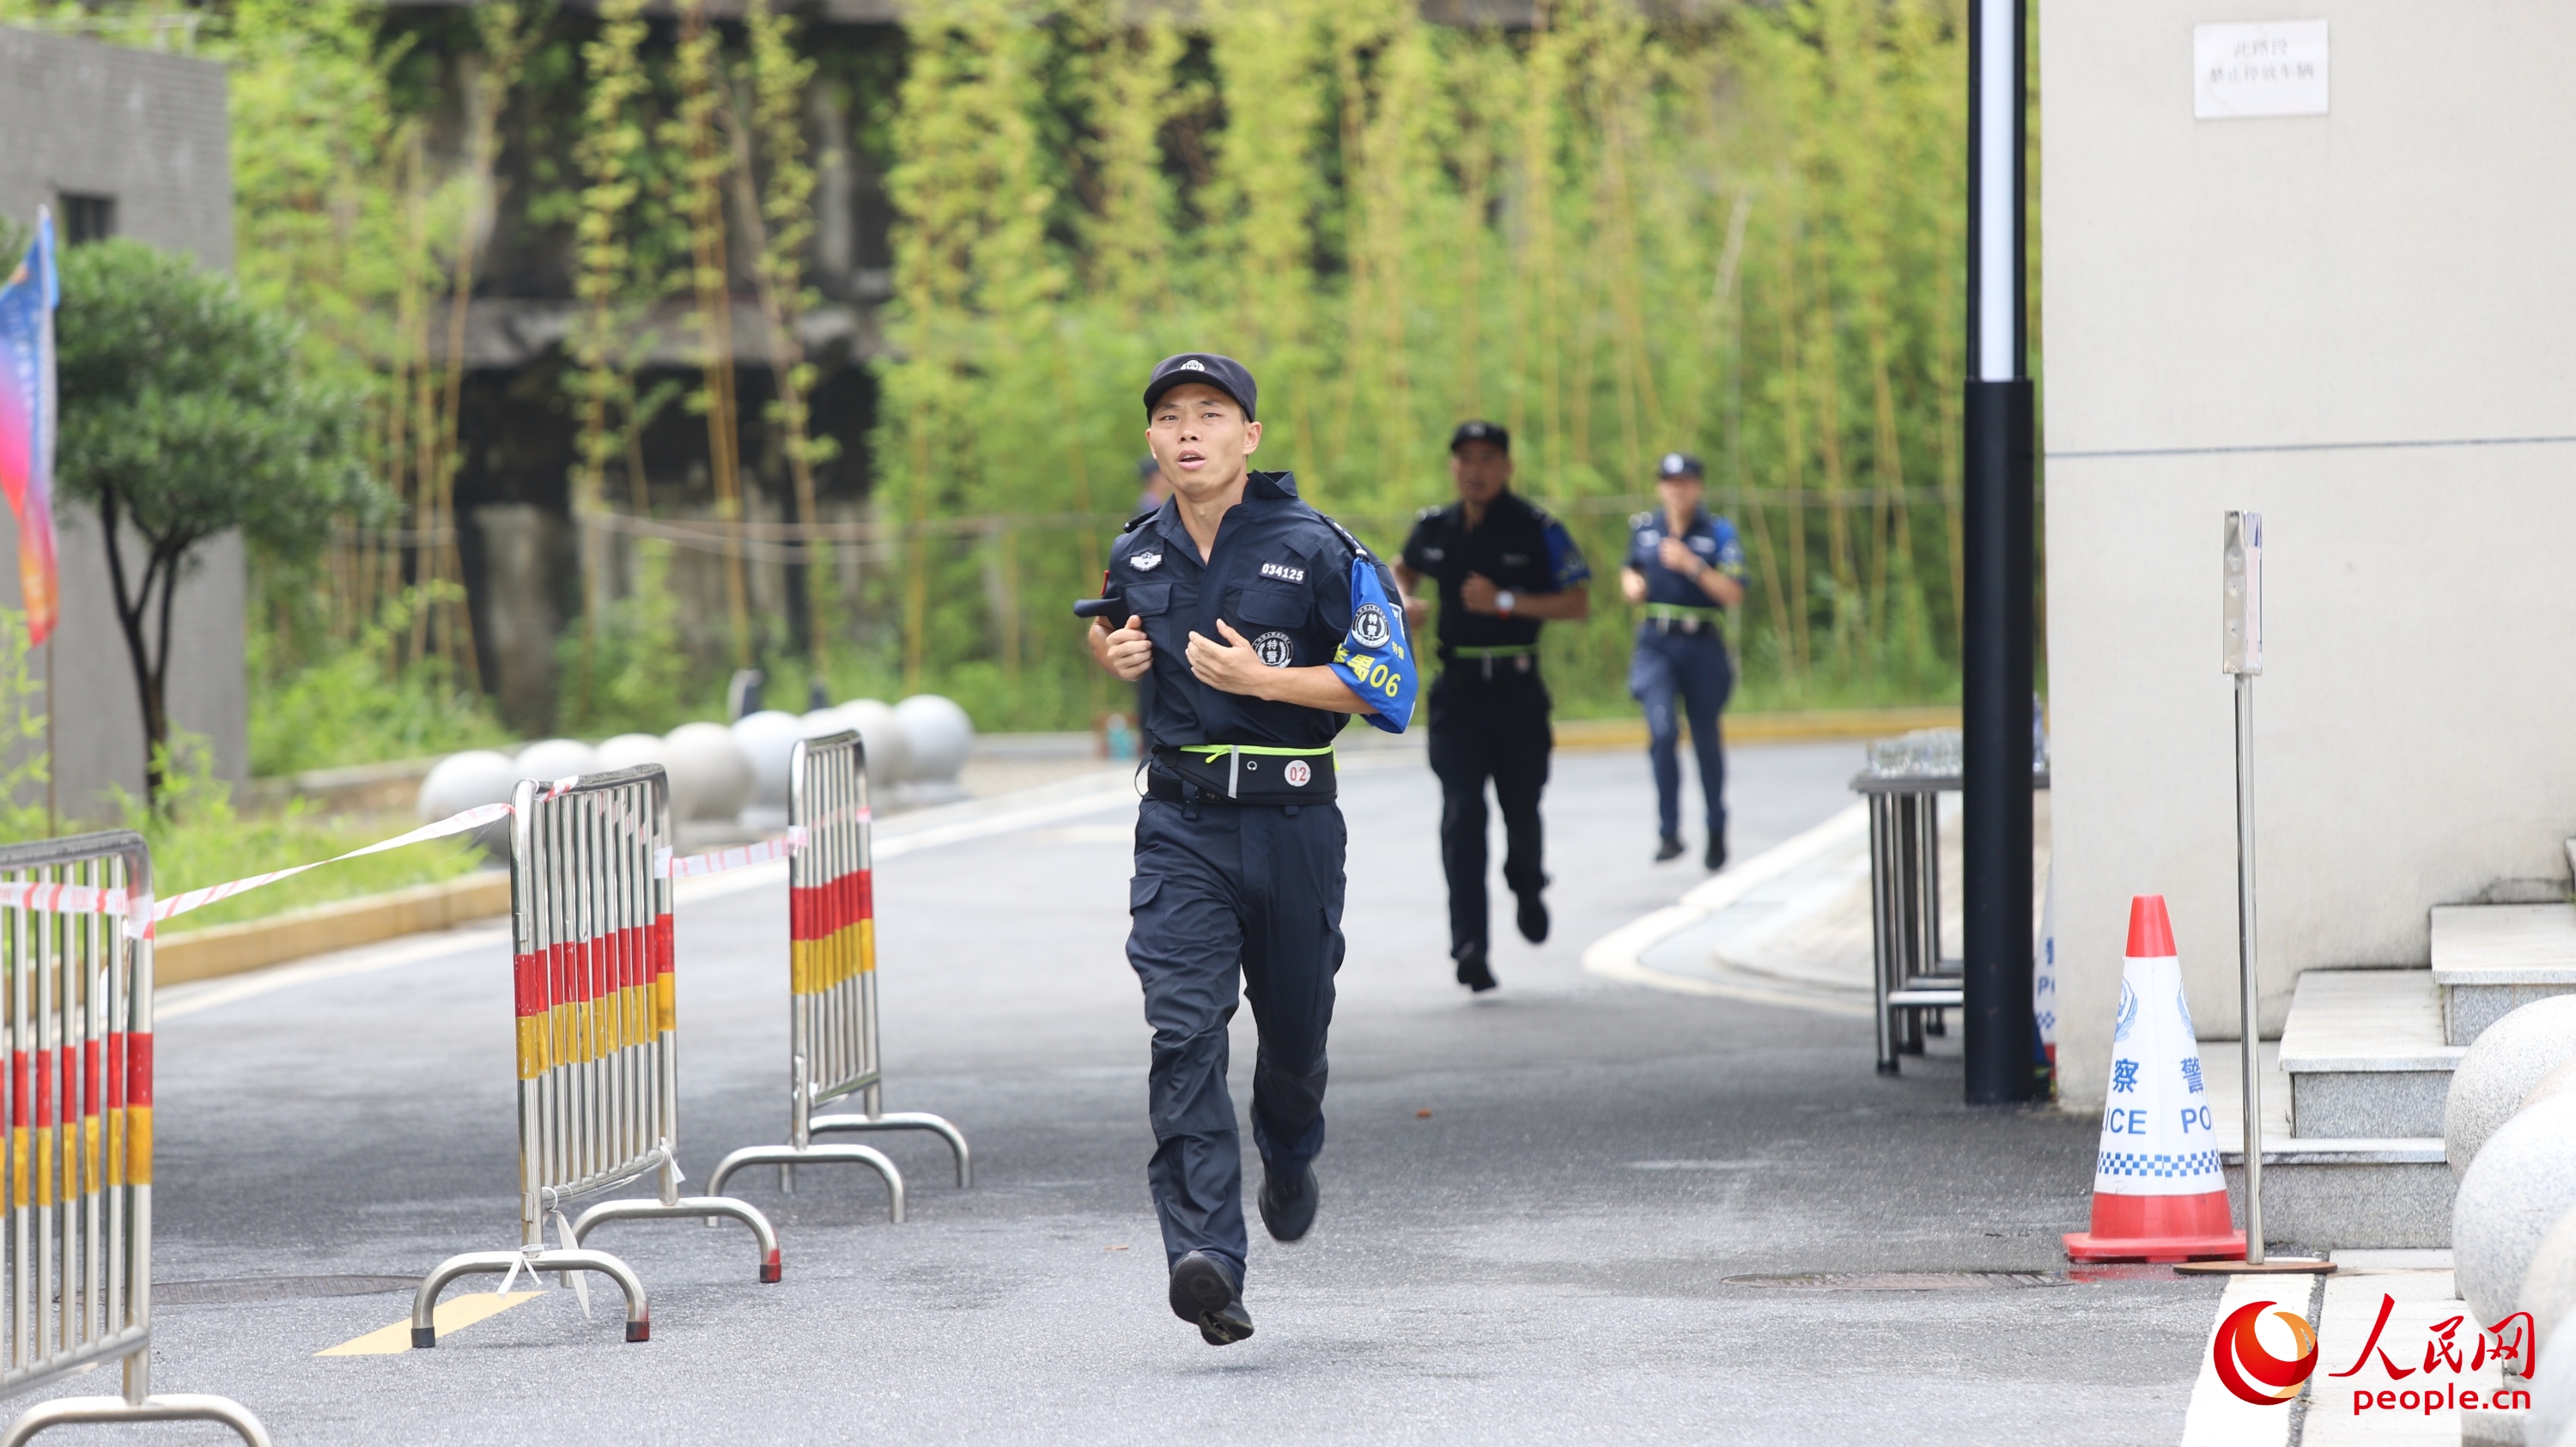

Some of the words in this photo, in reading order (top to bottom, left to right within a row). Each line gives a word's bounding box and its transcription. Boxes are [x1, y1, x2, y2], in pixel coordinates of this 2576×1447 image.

[1261, 563, 1304, 581] 034125
[1367, 613, 1378, 636] 特警
[1267, 639, 1279, 663] 特警
[1290, 766, 1307, 781] 02
[2112, 1058, 2139, 1093] 察
[2180, 1056, 2203, 1094] 警
[2101, 1107, 2148, 1134] ICE
